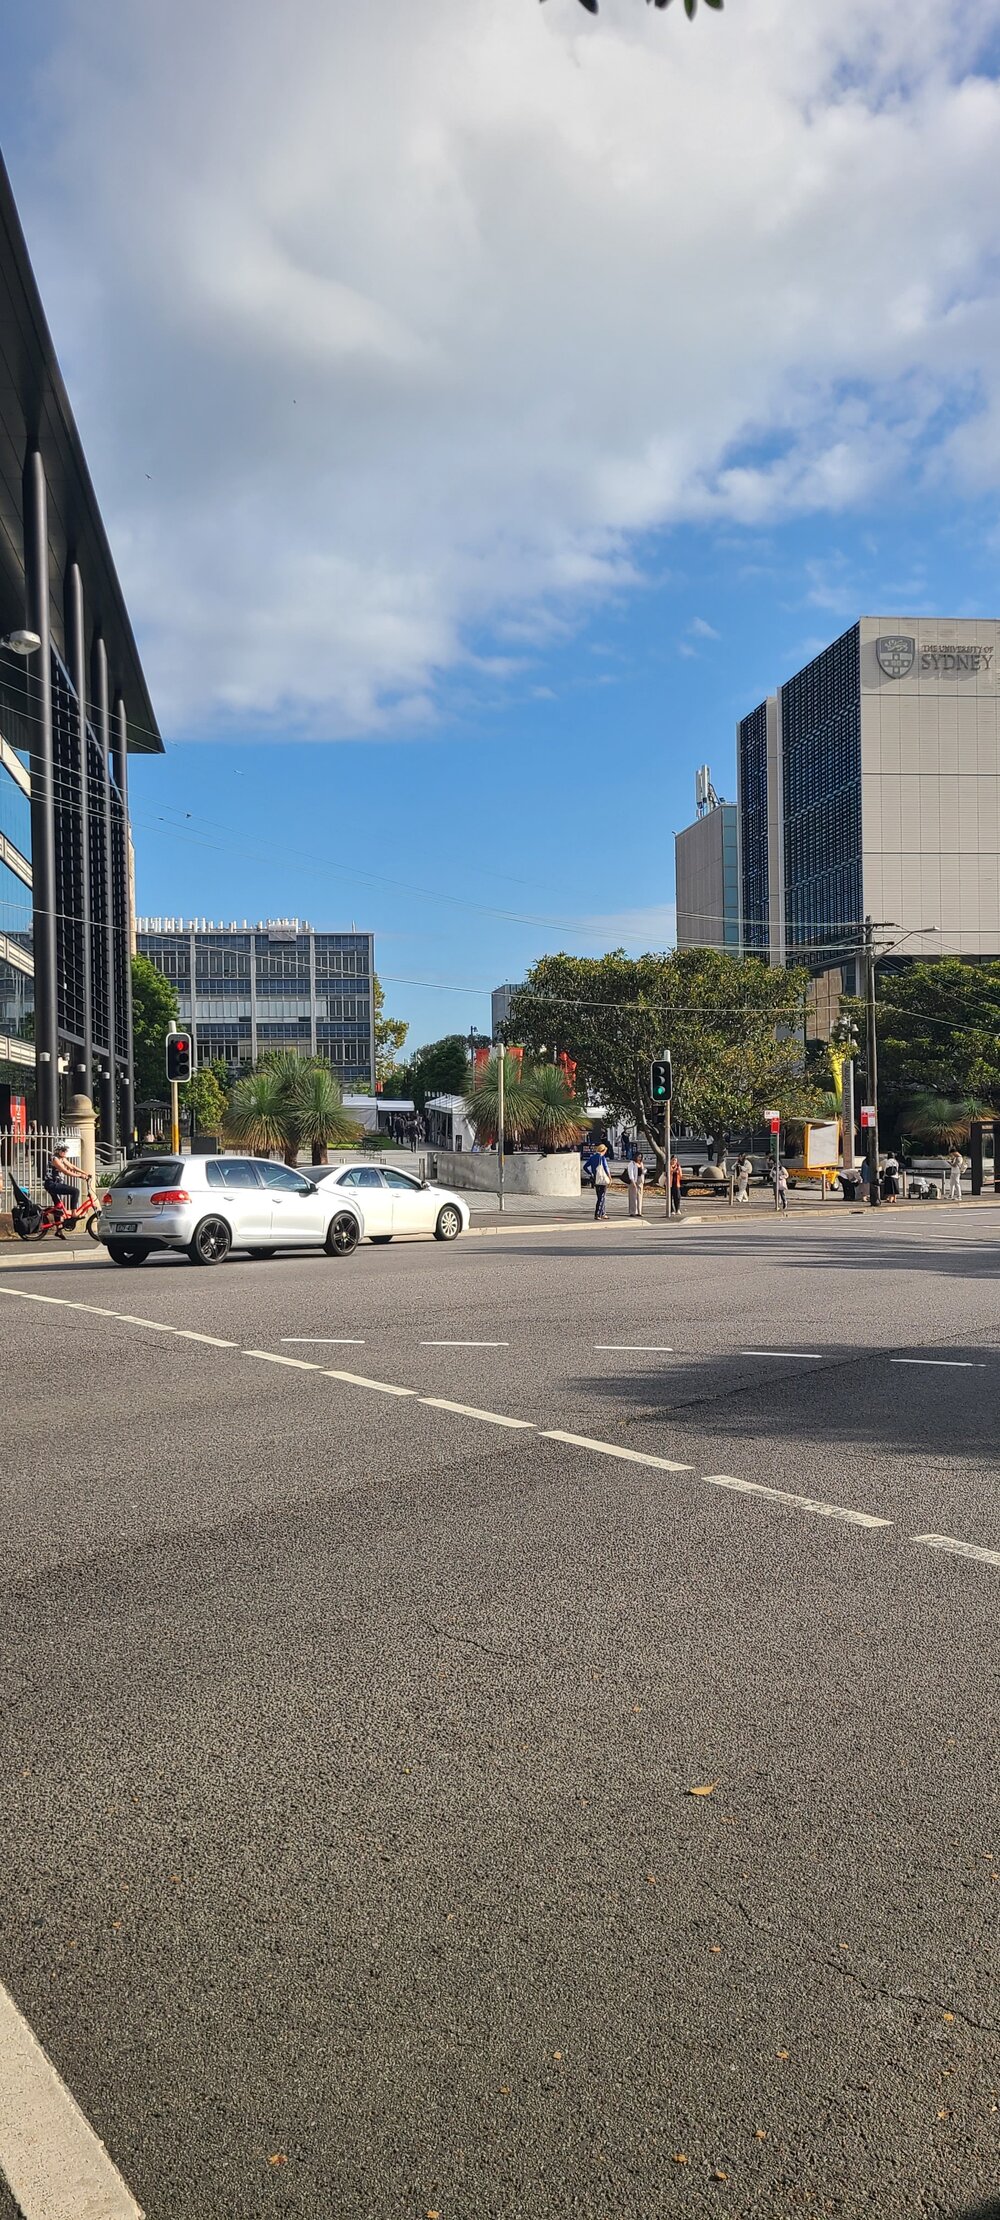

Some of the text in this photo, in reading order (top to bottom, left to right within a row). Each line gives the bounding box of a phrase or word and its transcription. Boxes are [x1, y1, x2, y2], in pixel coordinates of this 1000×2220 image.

[922, 645, 994, 654] THE UNIVERSITY OF
[921, 654, 994, 671] SYDNEY
